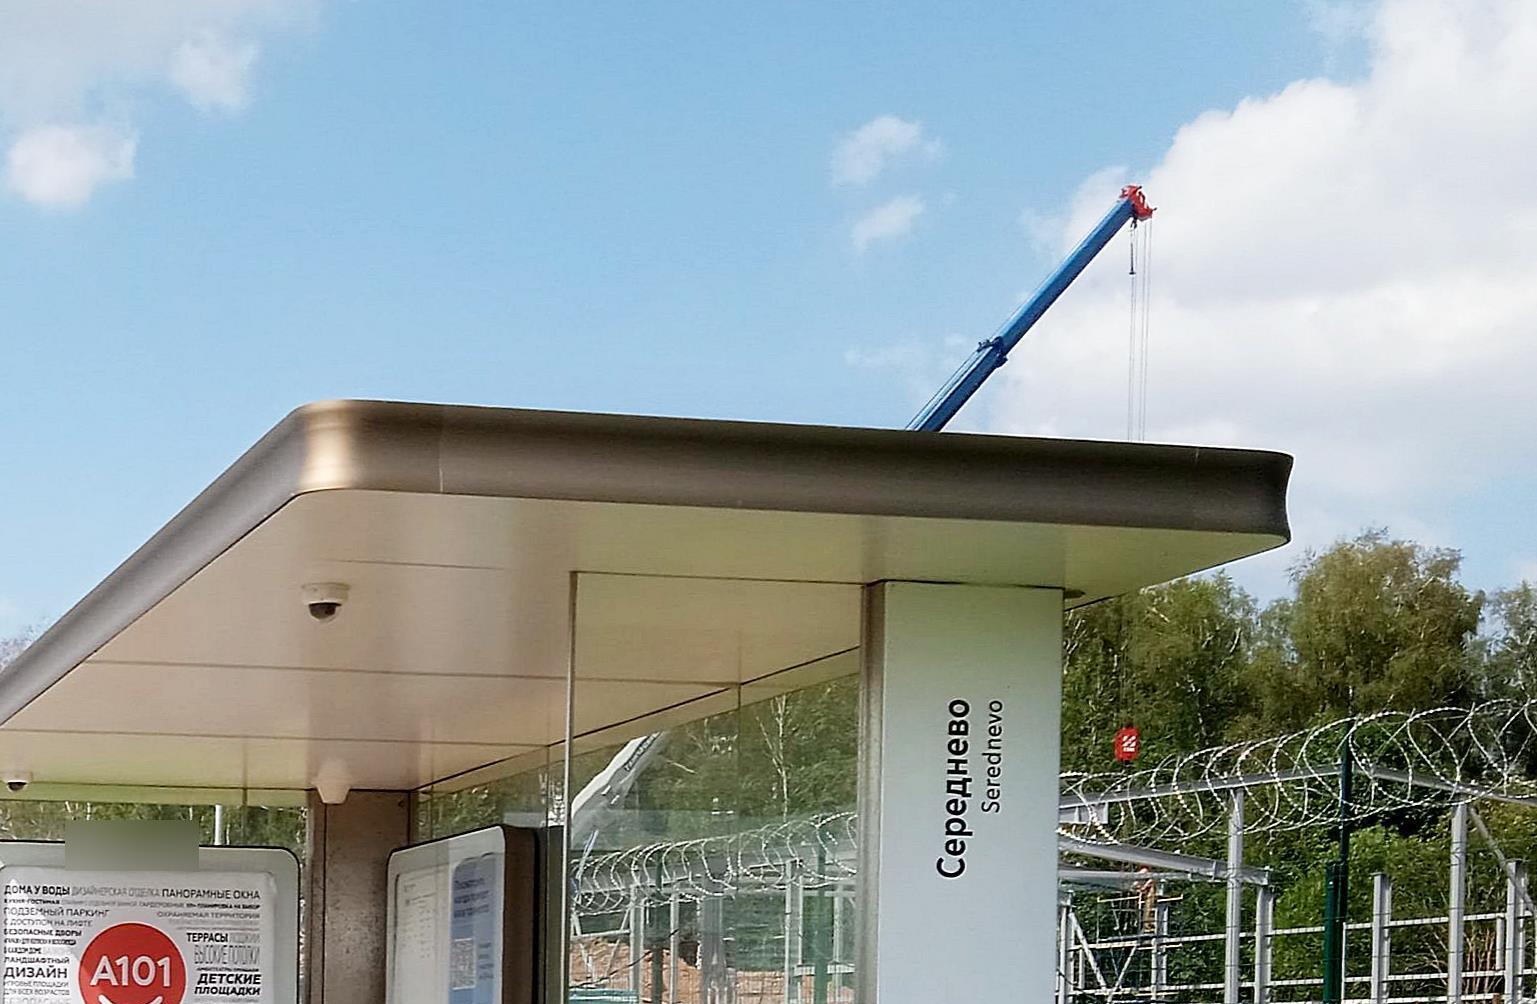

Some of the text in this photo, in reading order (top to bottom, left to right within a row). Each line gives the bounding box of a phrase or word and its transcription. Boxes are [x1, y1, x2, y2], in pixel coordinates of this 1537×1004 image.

[981, 700, 1003, 813] Serednevo
[936, 699, 973, 878] Середнево
[4, 885, 33, 896] ДОМА
[34, 885, 41, 895] У
[42, 886, 70, 896] ВОДЫ
[162, 888, 231, 899] ПАНОРАМНЫЕ
[233, 890, 260, 899] ОКНА
[4, 906, 110, 917] ПОДЗЕМНЫЙ ПАРКИНГ
[4, 928, 54, 936] БЕЗОПАСНЫЕ
[186, 932, 228, 942] ТЕРРАСЫ
[4, 965, 68, 979] ДИЗАЙН
[197, 974, 262, 985] ДЕТСКИЕ
[194, 986, 261, 996] ПЛОЩАДКИ
